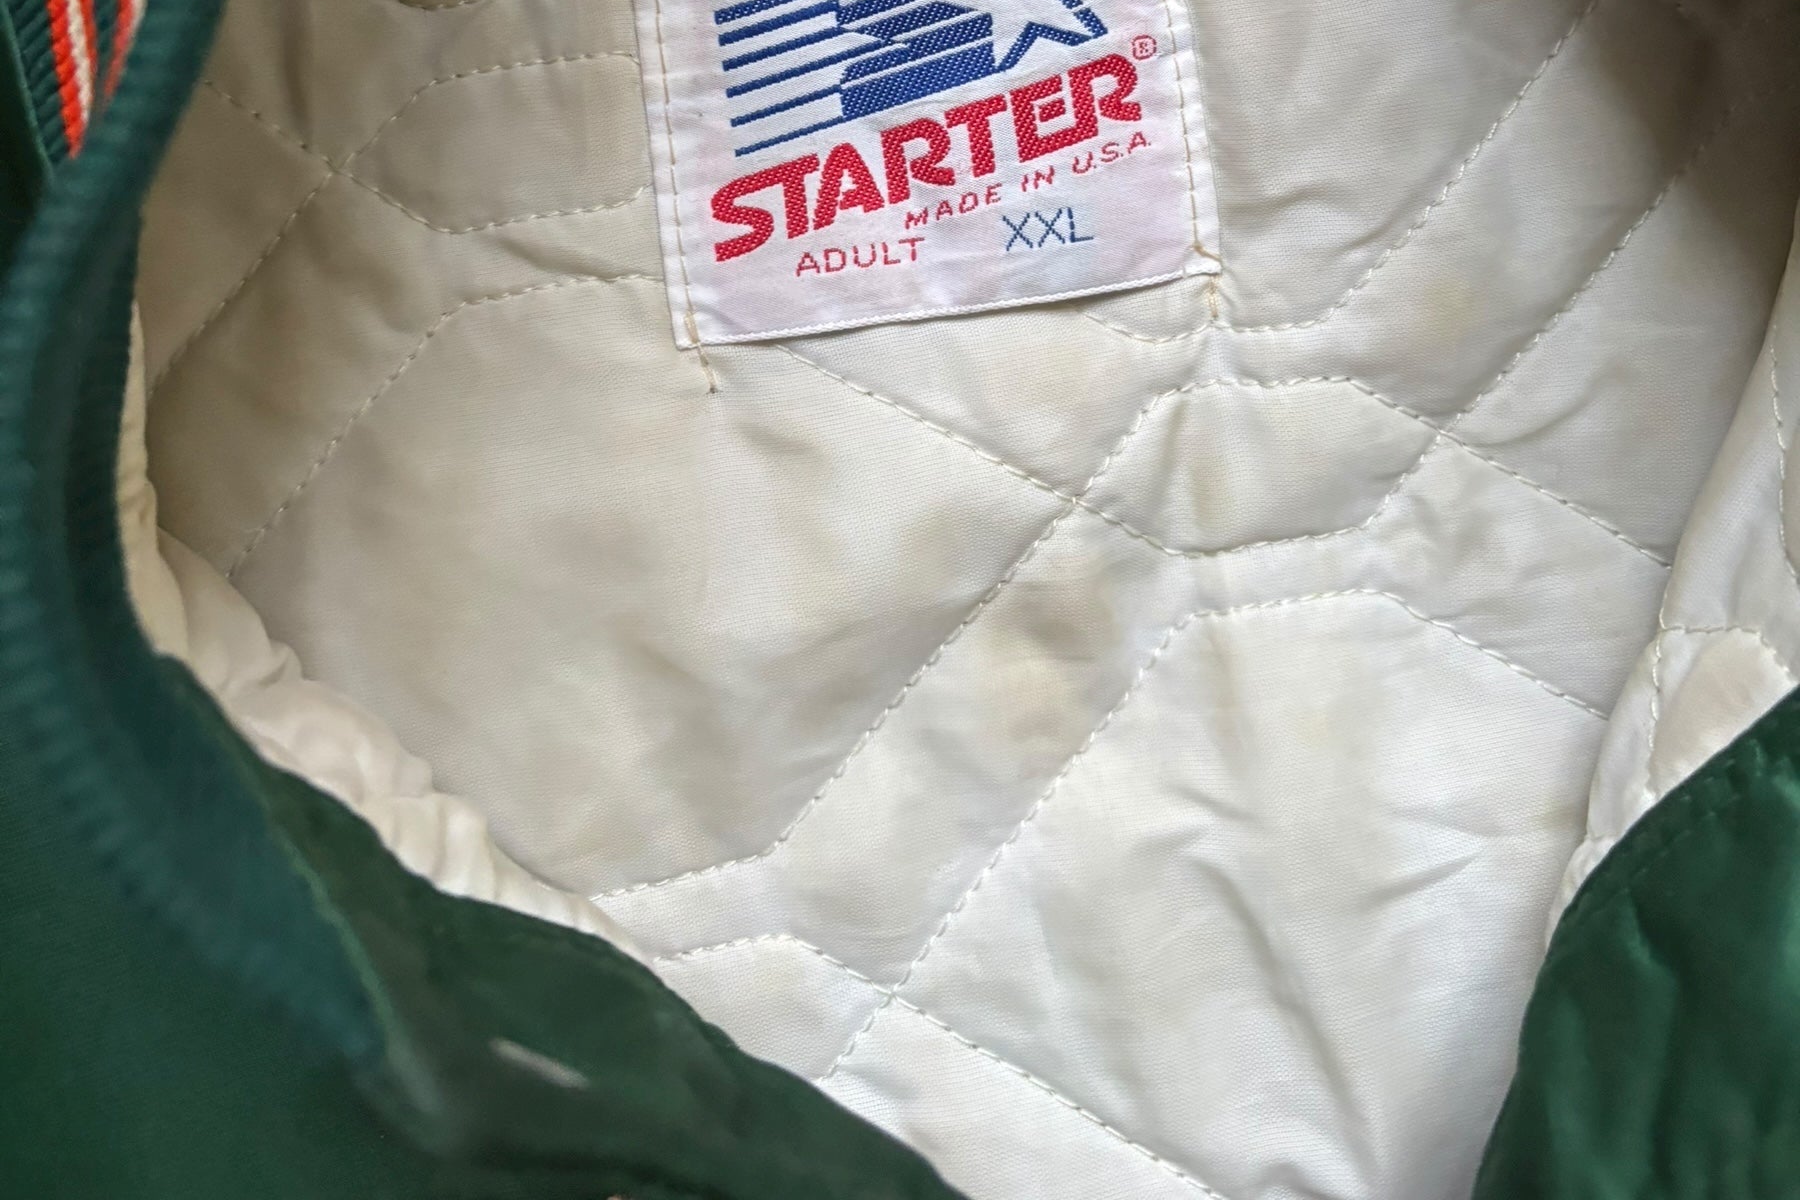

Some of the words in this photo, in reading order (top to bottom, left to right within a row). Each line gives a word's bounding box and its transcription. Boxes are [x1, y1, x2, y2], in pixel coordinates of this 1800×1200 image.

[904, 183, 1003, 230] MADE
[1021, 165, 1056, 193] IN
[796, 237, 925, 277] ADULT
[1002, 207, 1095, 252] XXL
